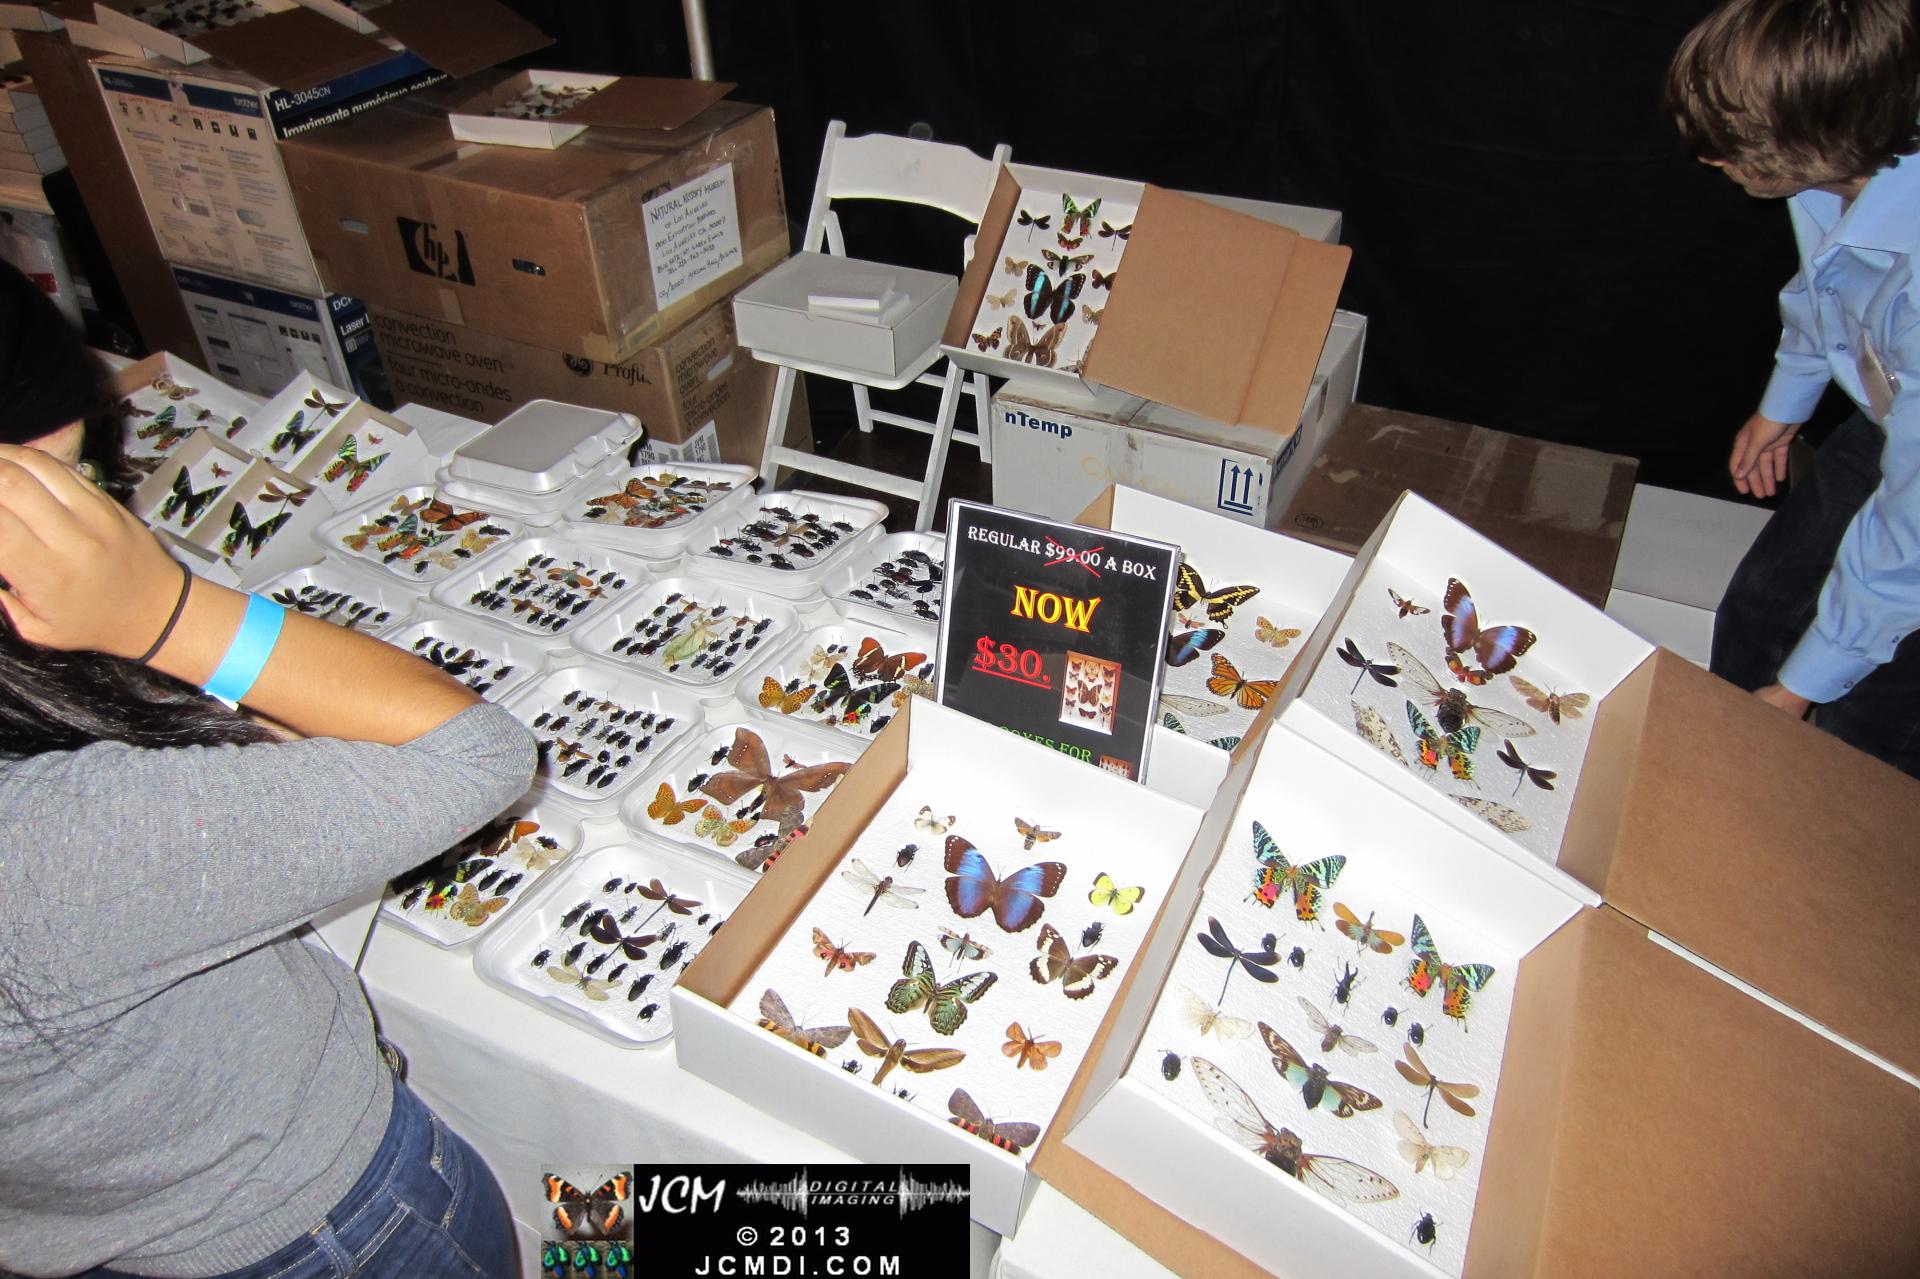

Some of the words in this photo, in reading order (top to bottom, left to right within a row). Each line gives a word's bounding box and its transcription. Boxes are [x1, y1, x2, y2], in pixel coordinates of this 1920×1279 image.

[650, 199, 682, 224] NATURAL
[340, 317, 364, 336] Laser
[375, 315, 457, 345] convection
[380, 333, 462, 363] microwave
[465, 352, 504, 373] oven
[675, 337, 715, 374] convection
[388, 356, 416, 377] four
[420, 368, 513, 402] micro-ondes
[603, 362, 652, 386] Profi
[407, 384, 485, 414] convection
[1005, 411, 1073, 439] nTemp
[968, 526, 1041, 555] REGULAR
[1044, 541, 1101, 567] $99.00
[1104, 556, 1118, 572] A
[1122, 560, 1157, 580] BOX
[1010, 585, 1102, 633] NOW
[1000, 726, 1054, 750] XES
[1060, 742, 1092, 764] FOR
